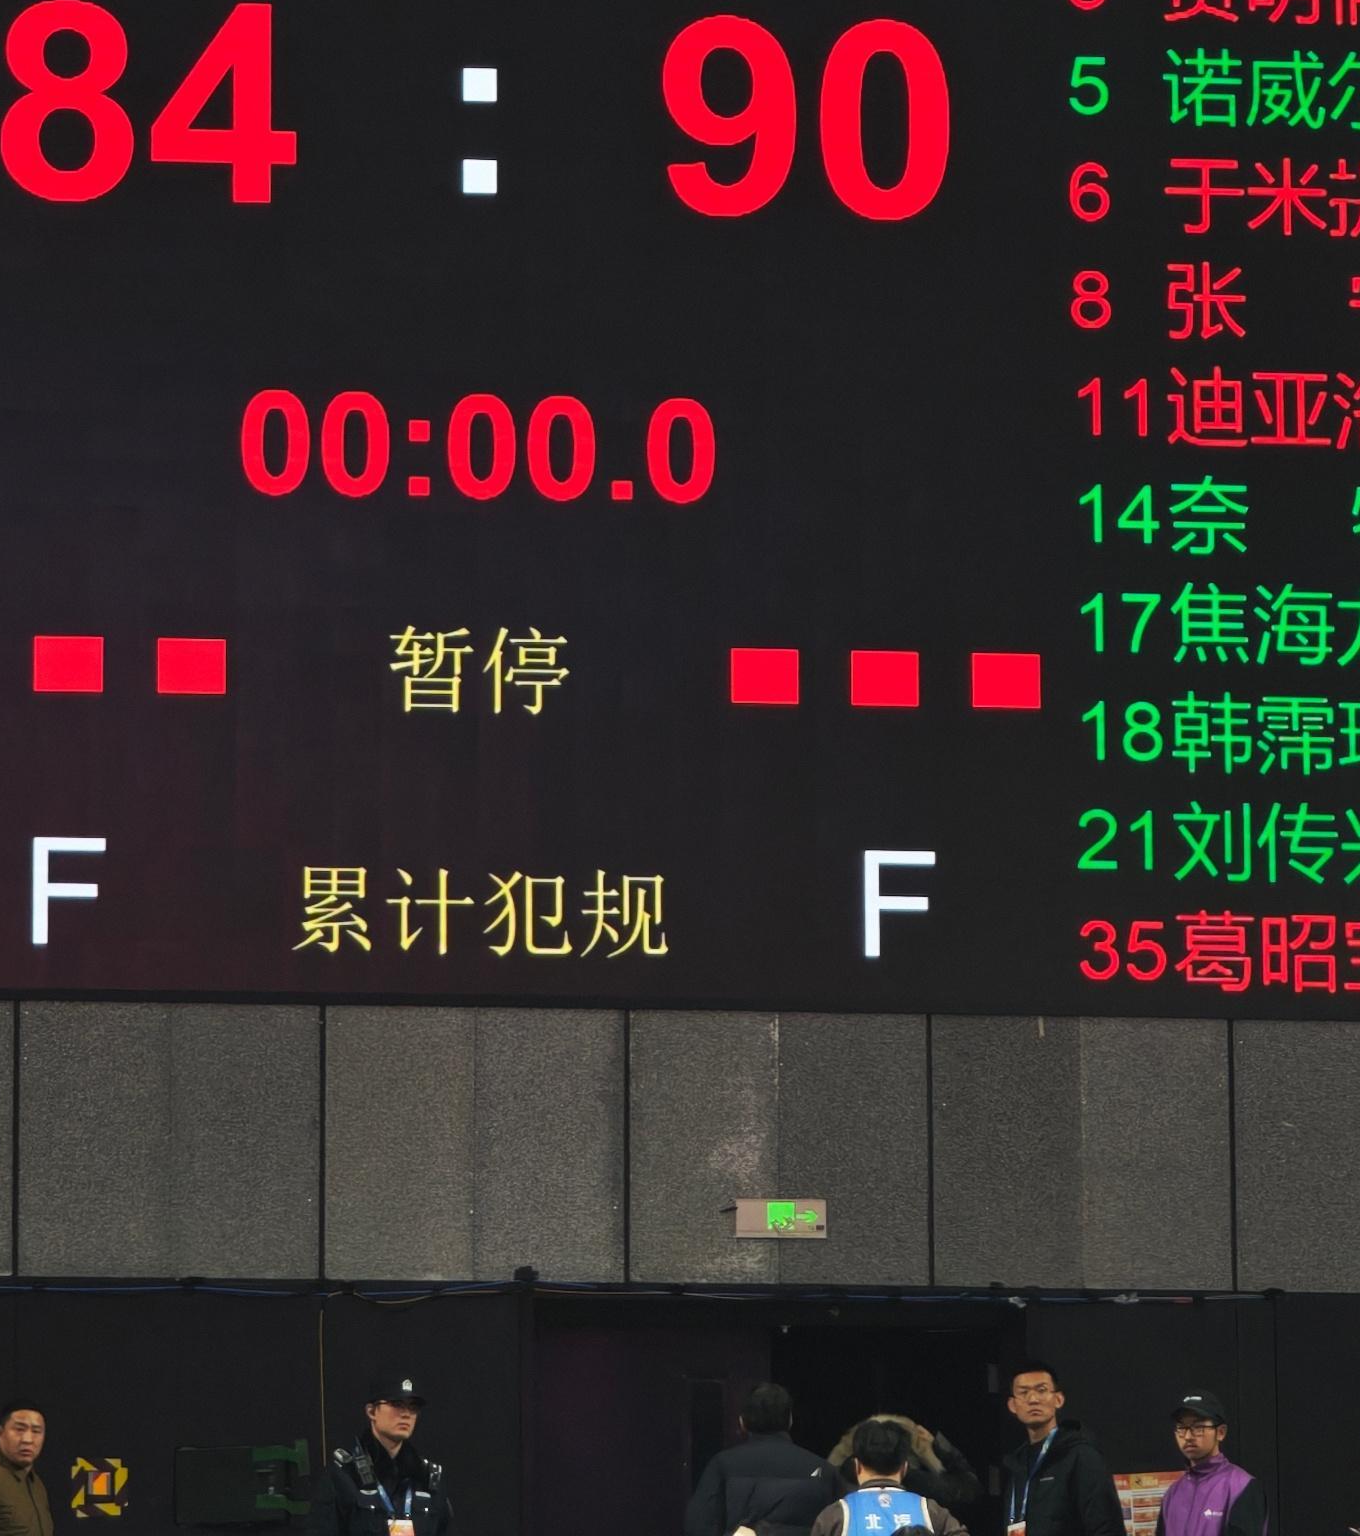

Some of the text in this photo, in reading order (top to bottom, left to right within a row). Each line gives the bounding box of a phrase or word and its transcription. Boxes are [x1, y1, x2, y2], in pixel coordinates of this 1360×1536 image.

[660, 13, 952, 223] 90
[1068, 55, 1110, 117] 5
[1067, 160, 1112, 224] 6
[1069, 269, 1113, 331] 8
[239, 388, 717, 507] 00:00.0
[388, 624, 571, 717] 暂停
[30, 835, 108, 947] F
[290, 864, 670, 959] 累计犯规
[862, 848, 937, 960] F
